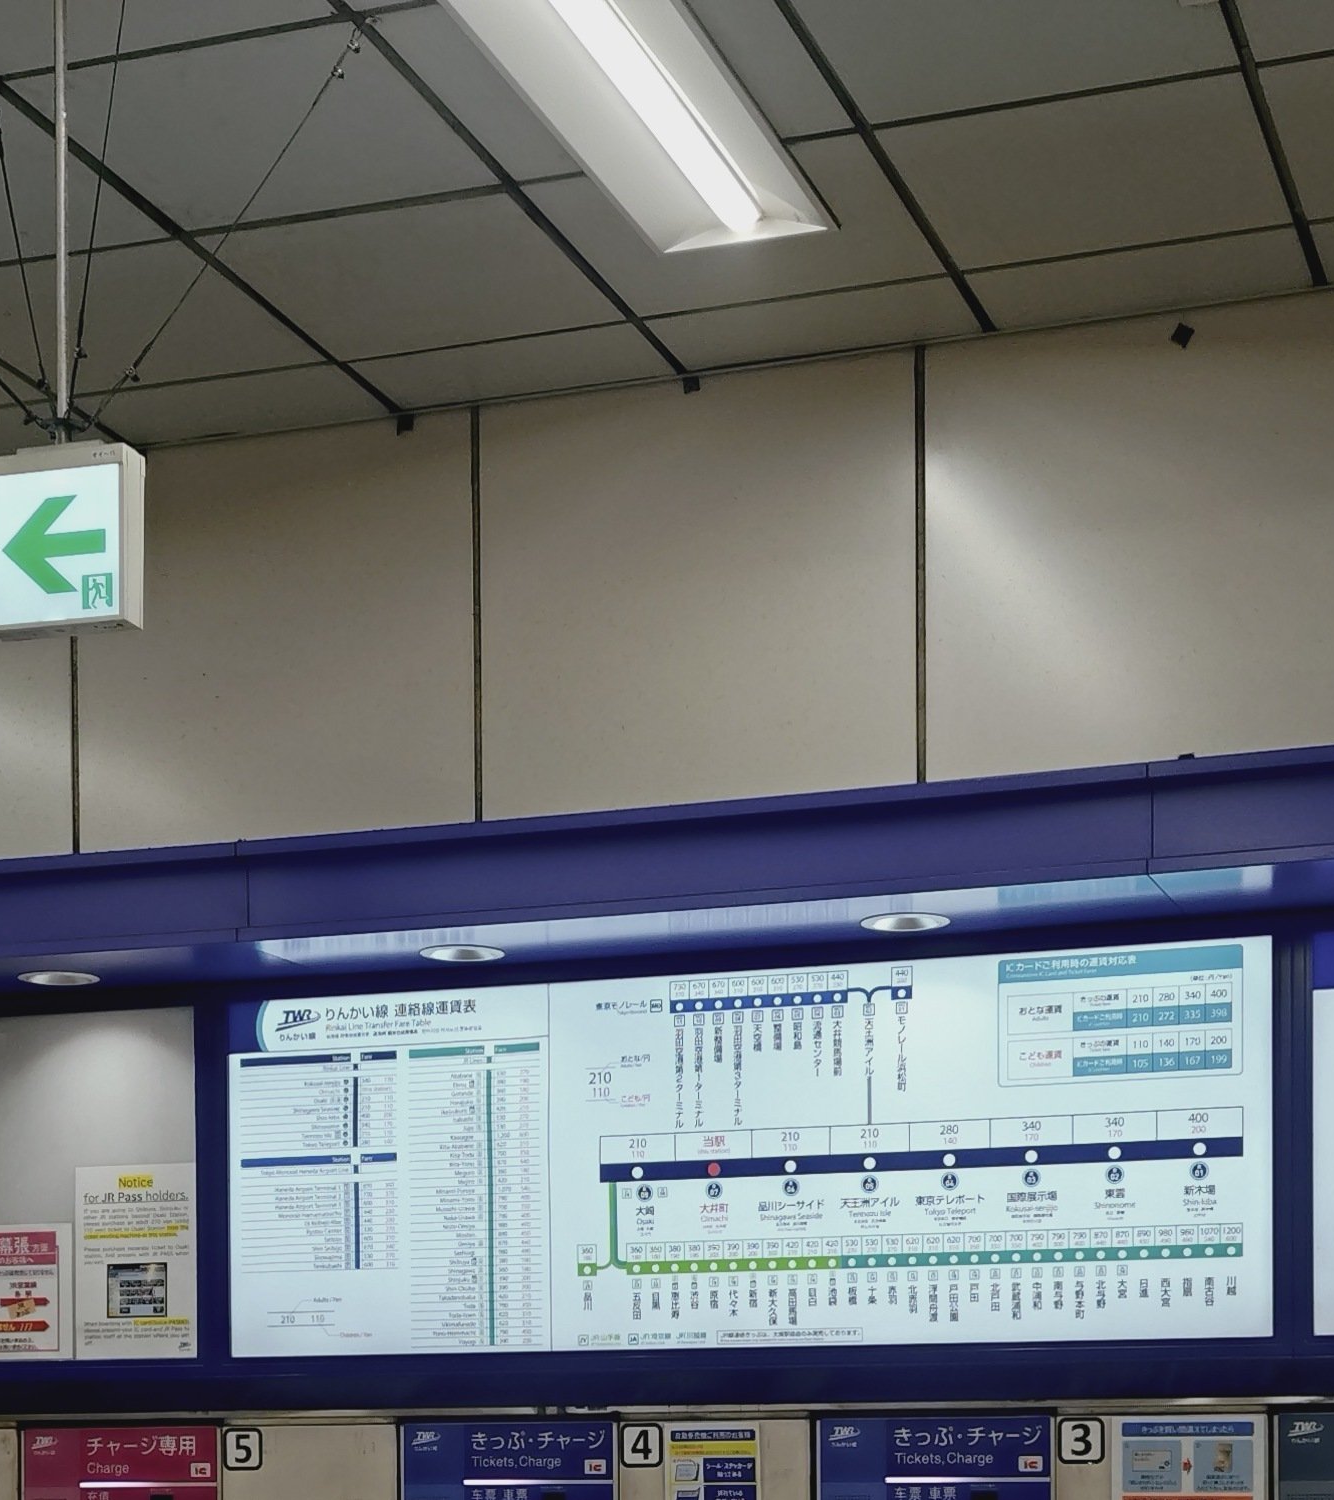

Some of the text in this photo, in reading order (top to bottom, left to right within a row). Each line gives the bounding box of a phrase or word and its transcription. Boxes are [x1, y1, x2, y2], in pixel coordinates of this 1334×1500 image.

[1132, 993, 1149, 1003] 210
[1158, 992, 1175, 1002] 280
[1184, 990, 1201, 1000] 340
[1210, 988, 1227, 998] 400
[278, 1009, 317, 1026] TWR
[325, 1005, 389, 1021] りんかい線
[1132, 1013, 1149, 1022] 210
[1158, 1011, 1175, 1021] 272
[589, 1072, 612, 1084] 210
[629, 1138, 647, 1149] 210
[781, 1131, 800, 1142] 210
[860, 1128, 879, 1139] 210
[939, 1124, 959, 1135] 280
[1022, 1120, 1042, 1132] 340
[1105, 1117, 1125, 1128] 340
[1188, 1112, 1209, 1123] 400
[119, 1178, 153, 1188] Notice
[84, 1190, 189, 1203] for JR Pass holders.
[758, 1199, 825, 1212] 品川シーサイド
[916, 1193, 985, 1206] 東京テレポート
[471, 1430, 605, 1450] きっぷ・チャージ
[631, 1430, 652, 1460] 4
[894, 1425, 1043, 1447] きっぷ・チャージ
[1071, 1424, 1092, 1456] 3
[87, 1435, 196, 1457] チャージ専用
[234, 1434, 252, 1463] 5
[87, 1462, 130, 1476] Charge
